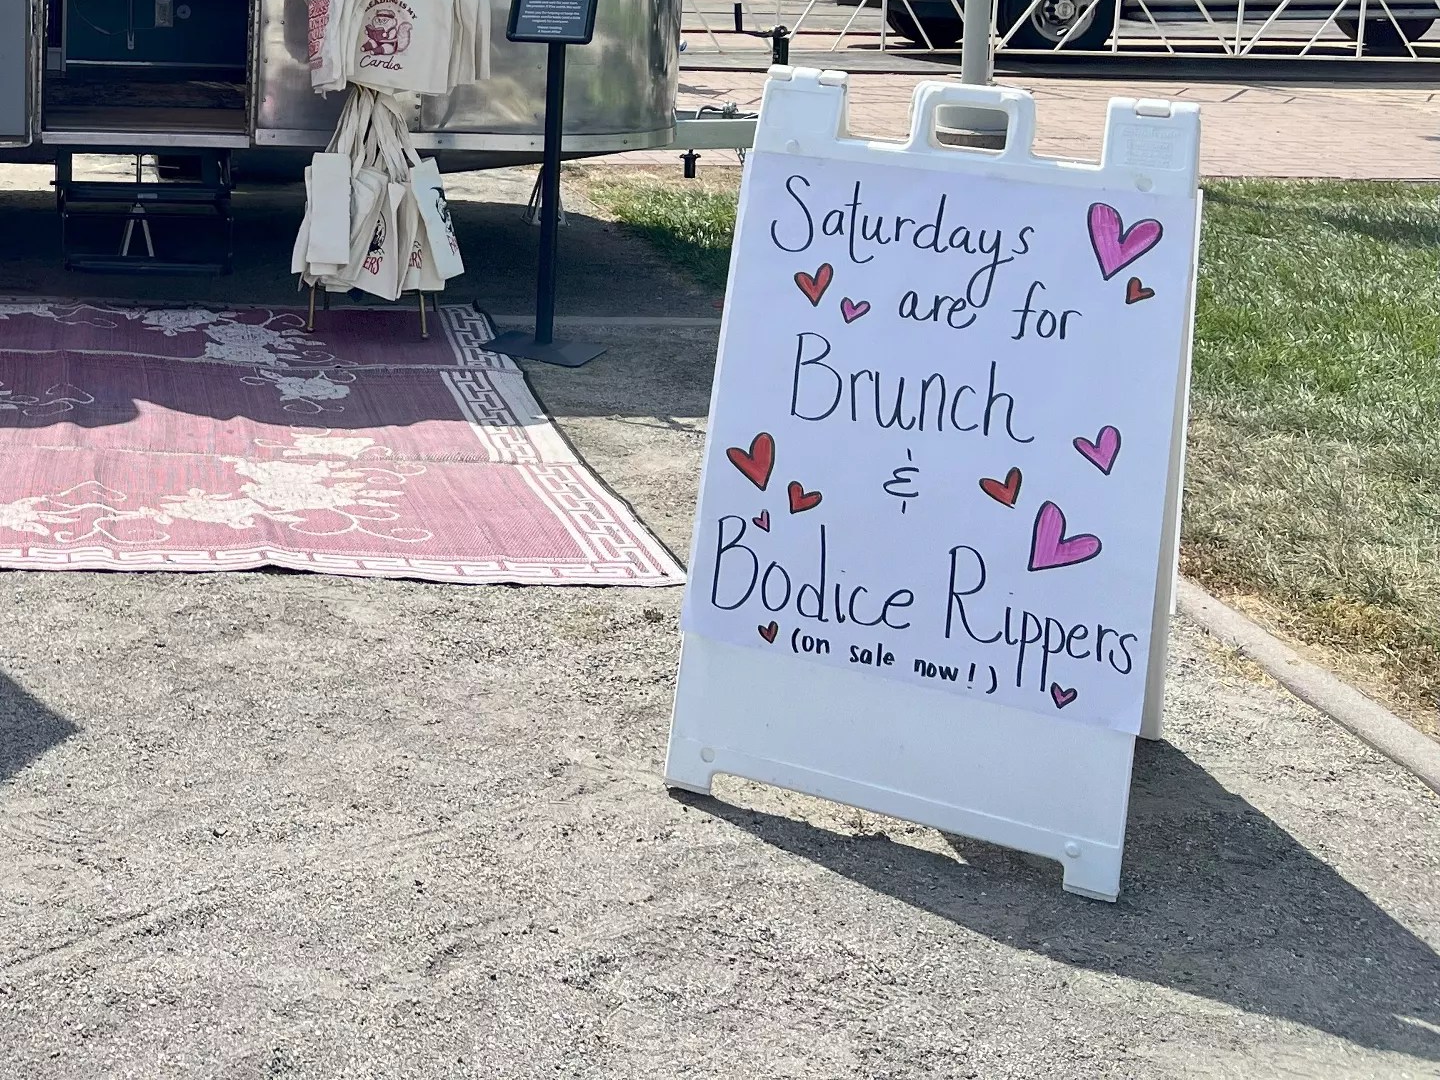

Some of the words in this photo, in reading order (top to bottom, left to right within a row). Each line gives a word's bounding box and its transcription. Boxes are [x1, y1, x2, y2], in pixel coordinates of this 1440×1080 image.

[360, 55, 403, 71] Cardio
[770, 174, 1035, 308] Saturdays
[898, 290, 977, 329] are
[1011, 280, 1083, 340] for
[790, 332, 1035, 444] Brunch
[882, 448, 920, 514] &
[711, 515, 914, 630] Bodice
[945, 545, 1138, 692] Rippers
[790, 627, 831, 655] (on
[849, 642, 896, 668] sale
